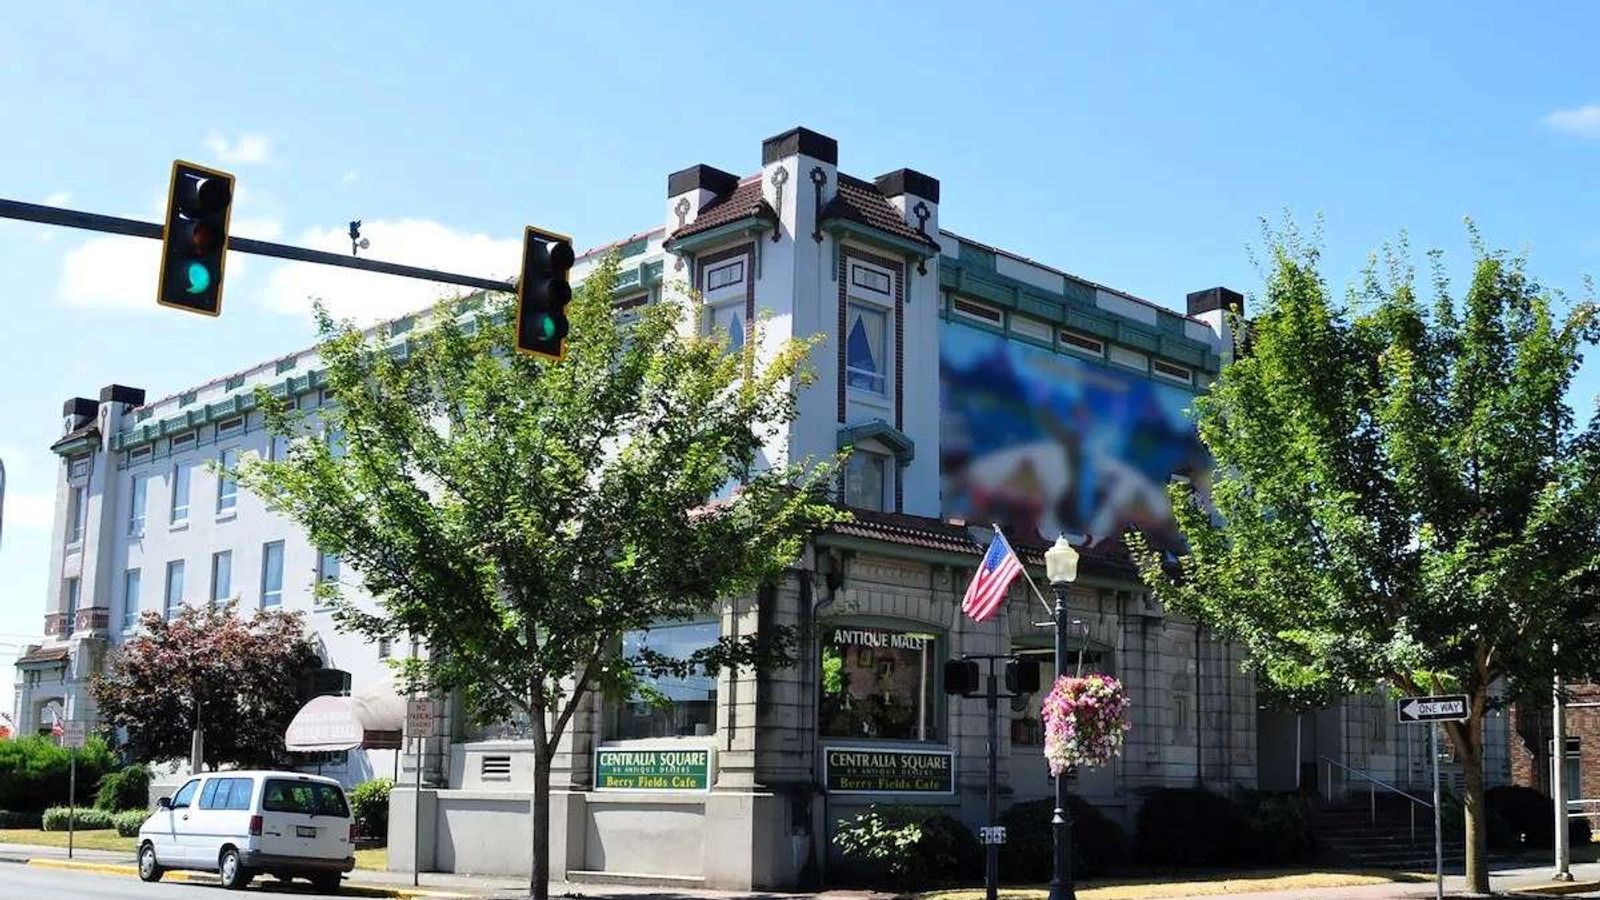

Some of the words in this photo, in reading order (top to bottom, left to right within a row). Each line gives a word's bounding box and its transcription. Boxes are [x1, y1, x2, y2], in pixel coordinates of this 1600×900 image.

[833, 629, 888, 647] ANTIQUE
[1419, 704, 1437, 714] ONE
[1441, 702, 1460, 712] WAY
[600, 752, 656, 766] CENTRALIA
[660, 752, 705, 767] SQUARE
[830, 752, 897, 768] CENTRALIA
[901, 755, 948, 771] SQUARE
[606, 776, 634, 788] Berry
[638, 776, 668, 788] Fields
[672, 776, 697, 788] Cafe
